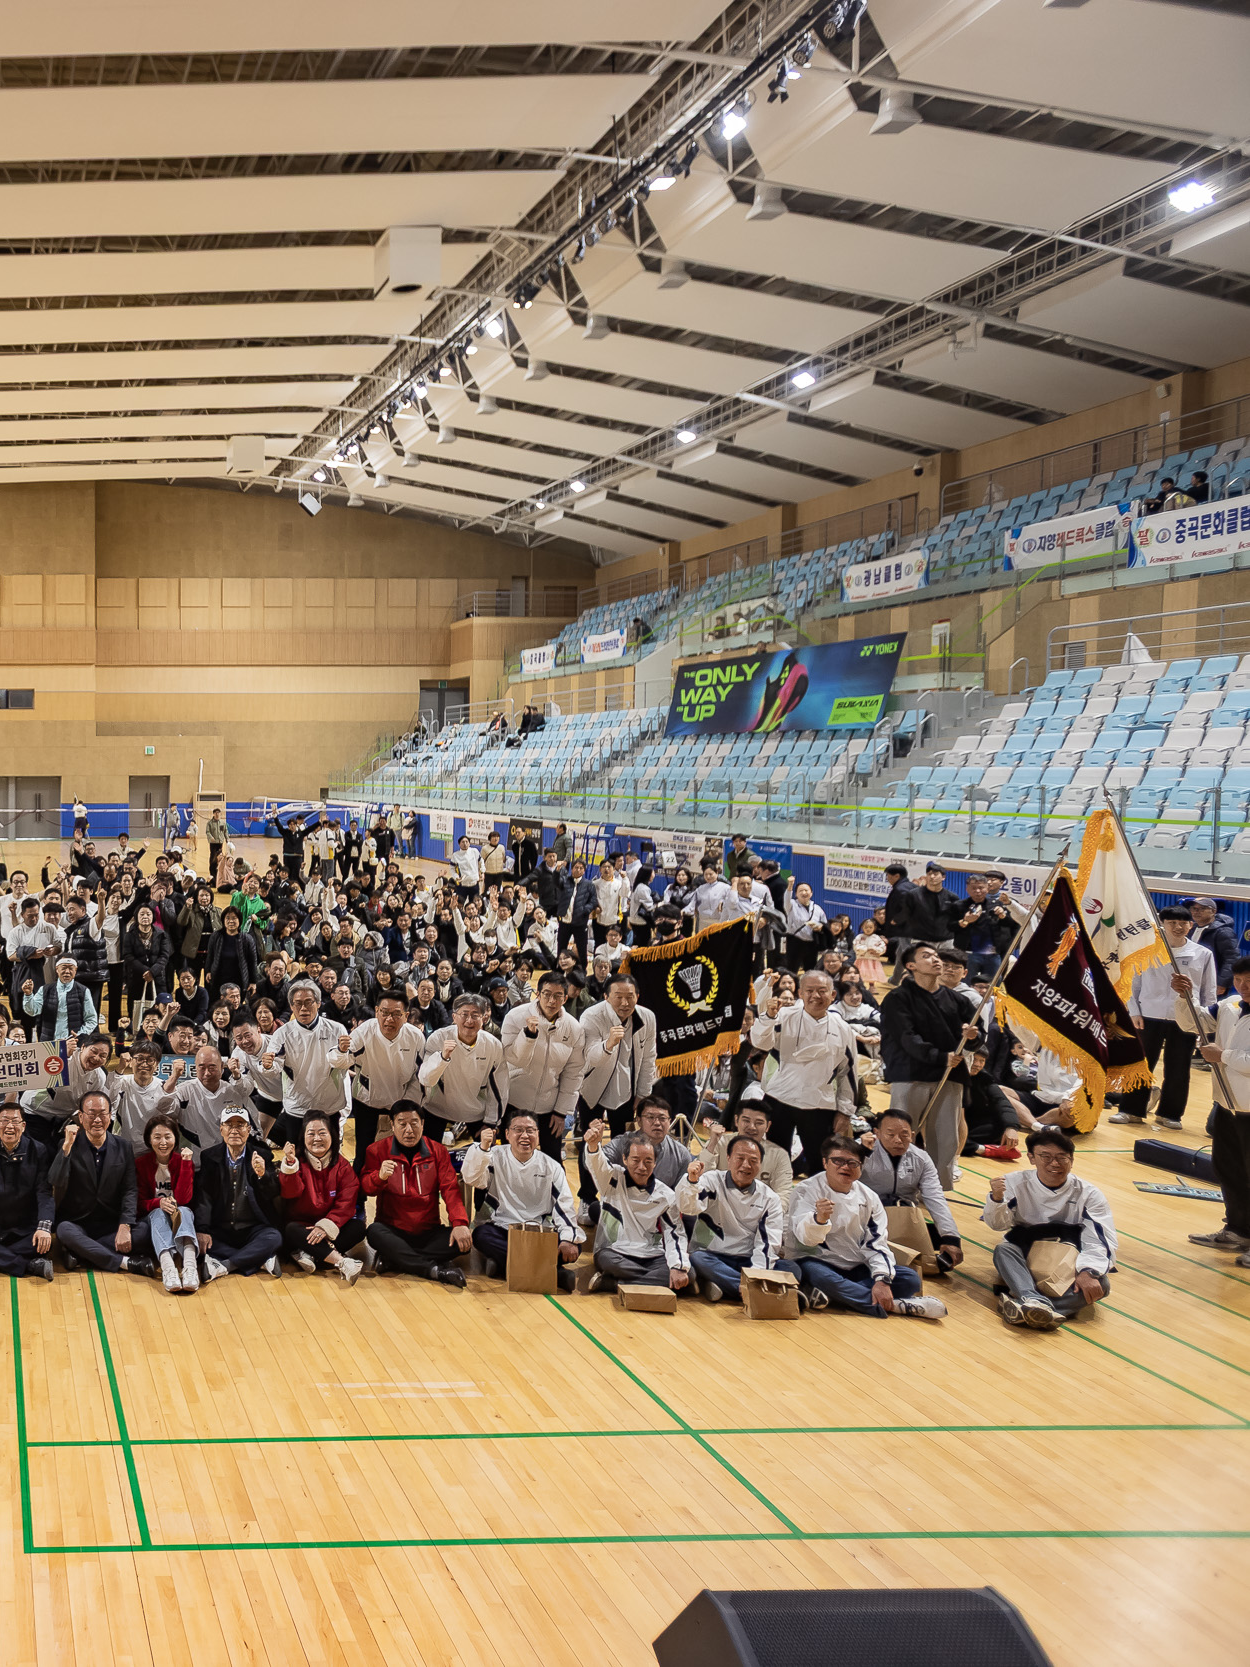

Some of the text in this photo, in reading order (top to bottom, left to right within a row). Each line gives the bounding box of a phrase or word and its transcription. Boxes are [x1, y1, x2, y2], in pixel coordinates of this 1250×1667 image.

[1175, 505, 1250, 543] 중곡문화클럽
[1037, 520, 1115, 552] 자양레드콕스클럽
[1137, 528, 1150, 546] 필
[864, 561, 903, 587] 광남클럽
[875, 641, 899, 655] YONEX
[684, 662, 761, 687] THE ONLY
[680, 684, 734, 705] WAY
[682, 704, 716, 722] UP
[665, 856, 676, 864] 22
[46, 1058, 62, 1072] 승
